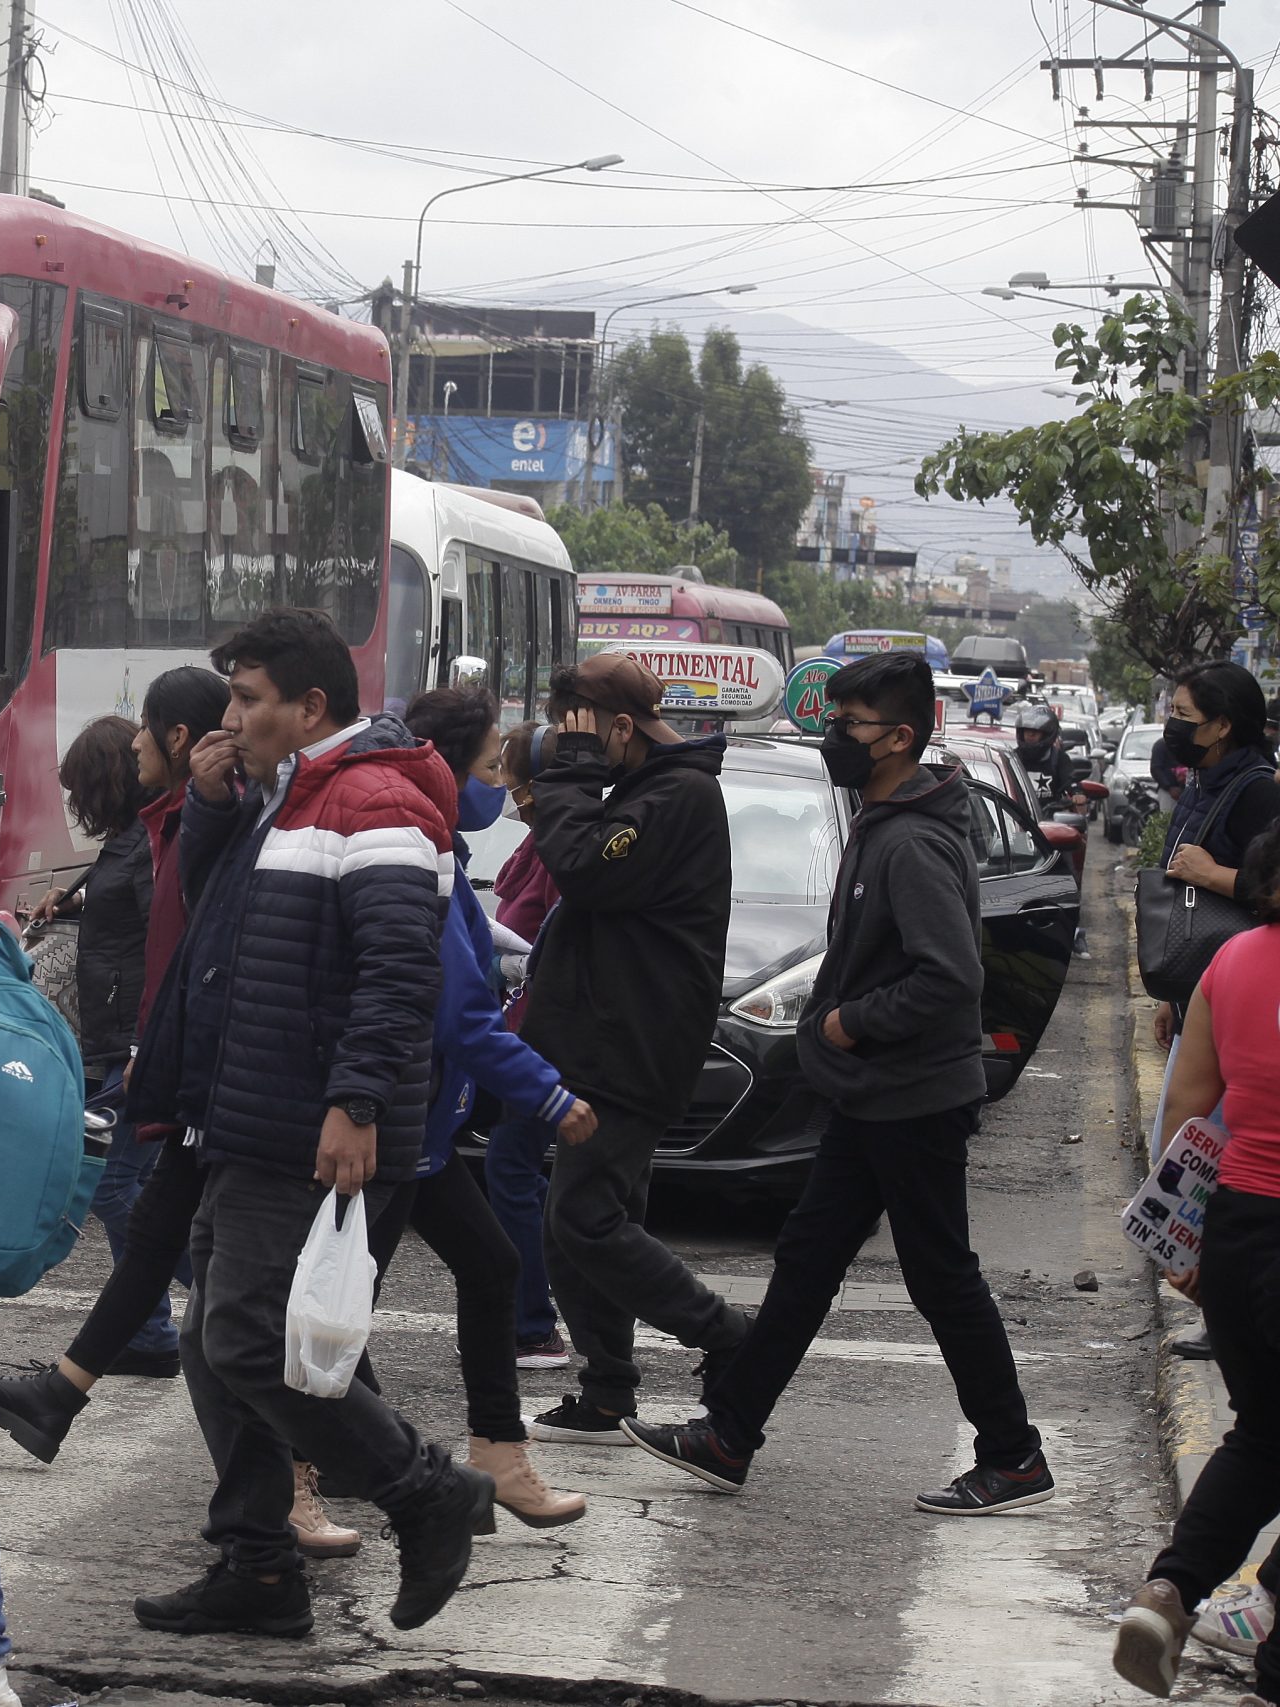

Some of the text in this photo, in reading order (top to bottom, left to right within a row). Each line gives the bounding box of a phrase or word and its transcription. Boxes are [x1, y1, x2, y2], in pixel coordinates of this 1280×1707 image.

[511, 459, 545, 473] entel
[579, 623, 669, 638] BUS AQP
[800, 670, 828, 684] Alo
[661, 699, 719, 707] PRESS
[1184, 1125, 1223, 1164] SERV
